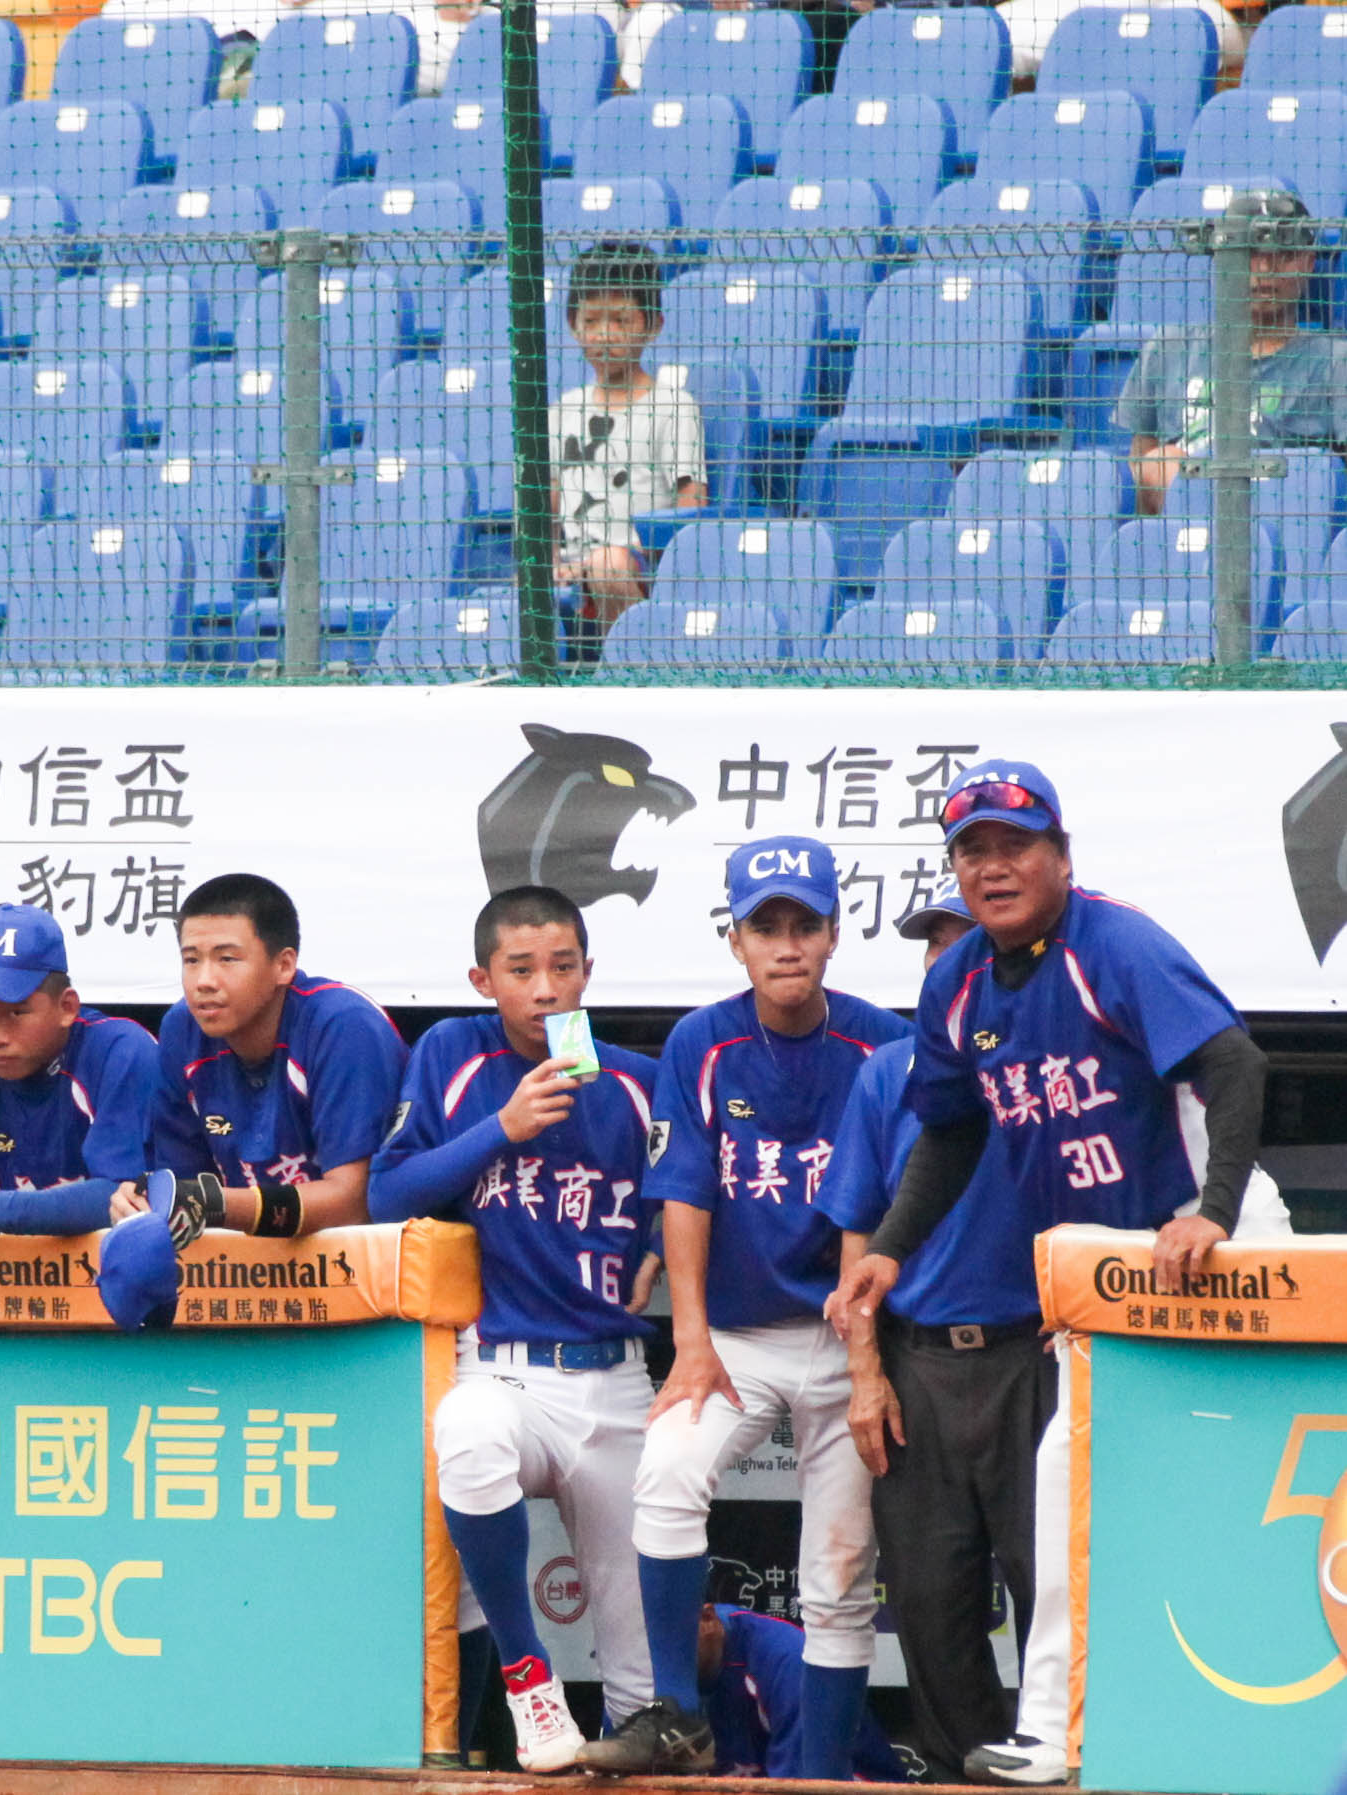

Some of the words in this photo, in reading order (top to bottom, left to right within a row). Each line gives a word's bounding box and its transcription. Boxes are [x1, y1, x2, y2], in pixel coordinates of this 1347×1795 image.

[748, 850, 813, 880] CM
[1061, 1134, 1123, 1189] 30
[577, 1252, 623, 1305] 16
[185, 1297, 328, 1322] 德國馬牌輪胎
[1127, 1304, 1269, 1333] 德國馬牌輪胎
